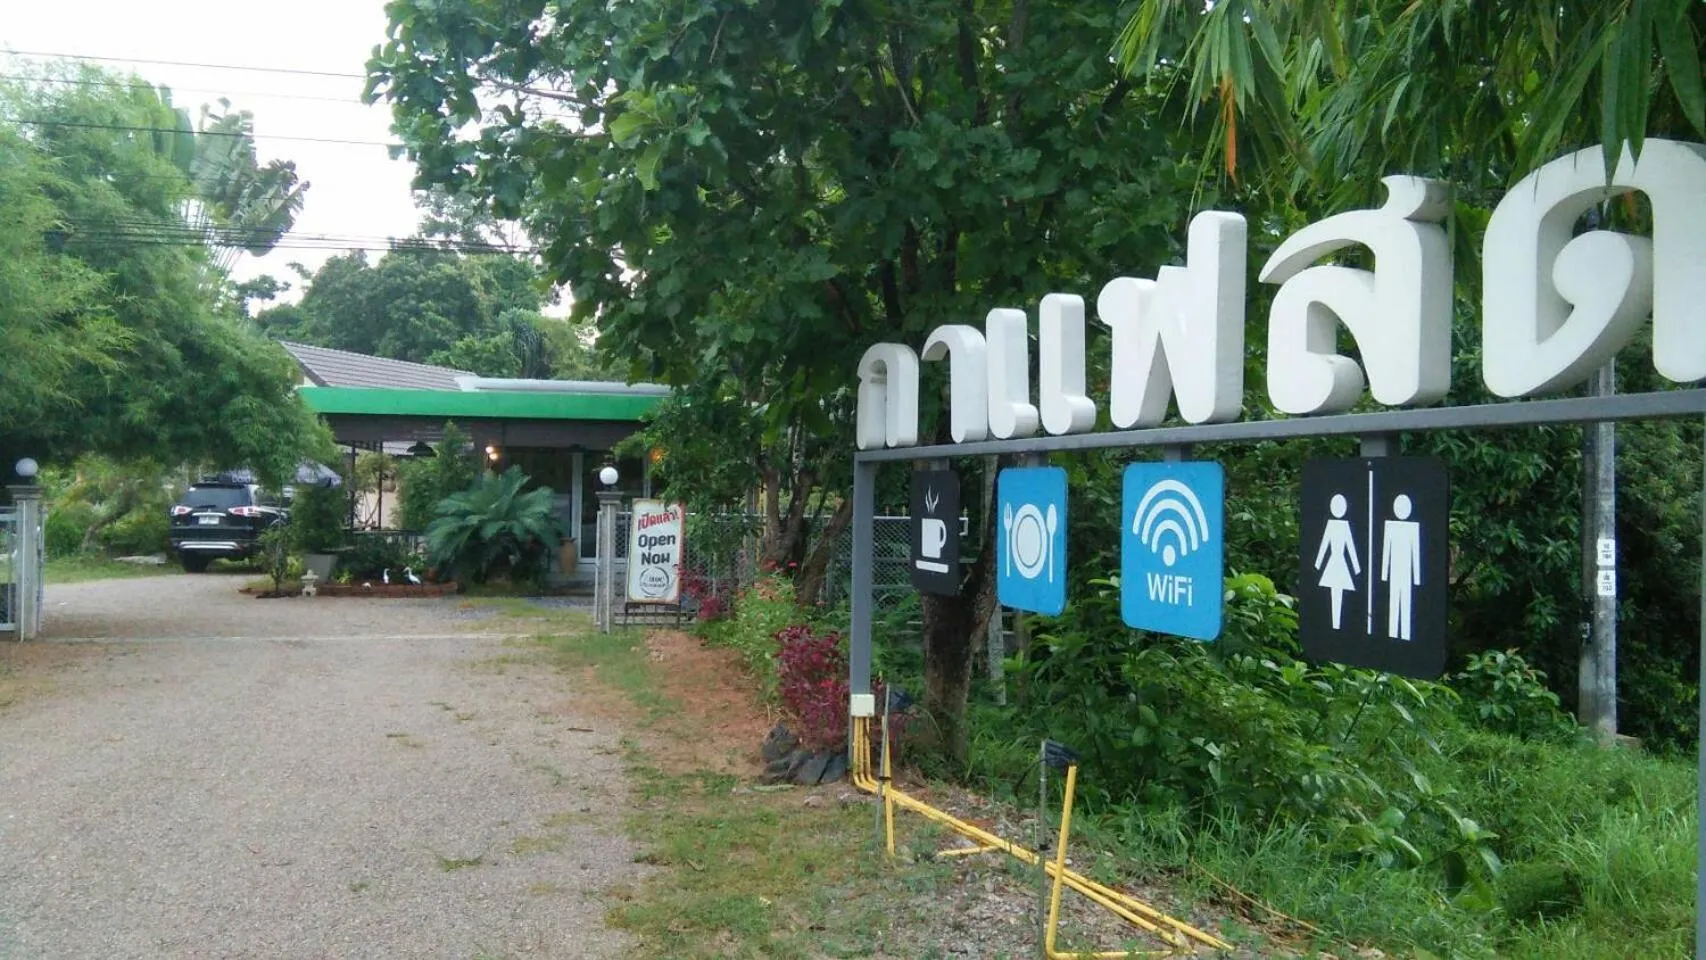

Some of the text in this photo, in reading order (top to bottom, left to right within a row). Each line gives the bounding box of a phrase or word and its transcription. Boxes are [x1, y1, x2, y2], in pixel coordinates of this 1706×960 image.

[856, 138, 1706, 450] กาแฟสด
[638, 509, 680, 531] เปิดแลว!
[637, 533, 676, 549] Open
[1146, 572, 1193, 607] WiFi
